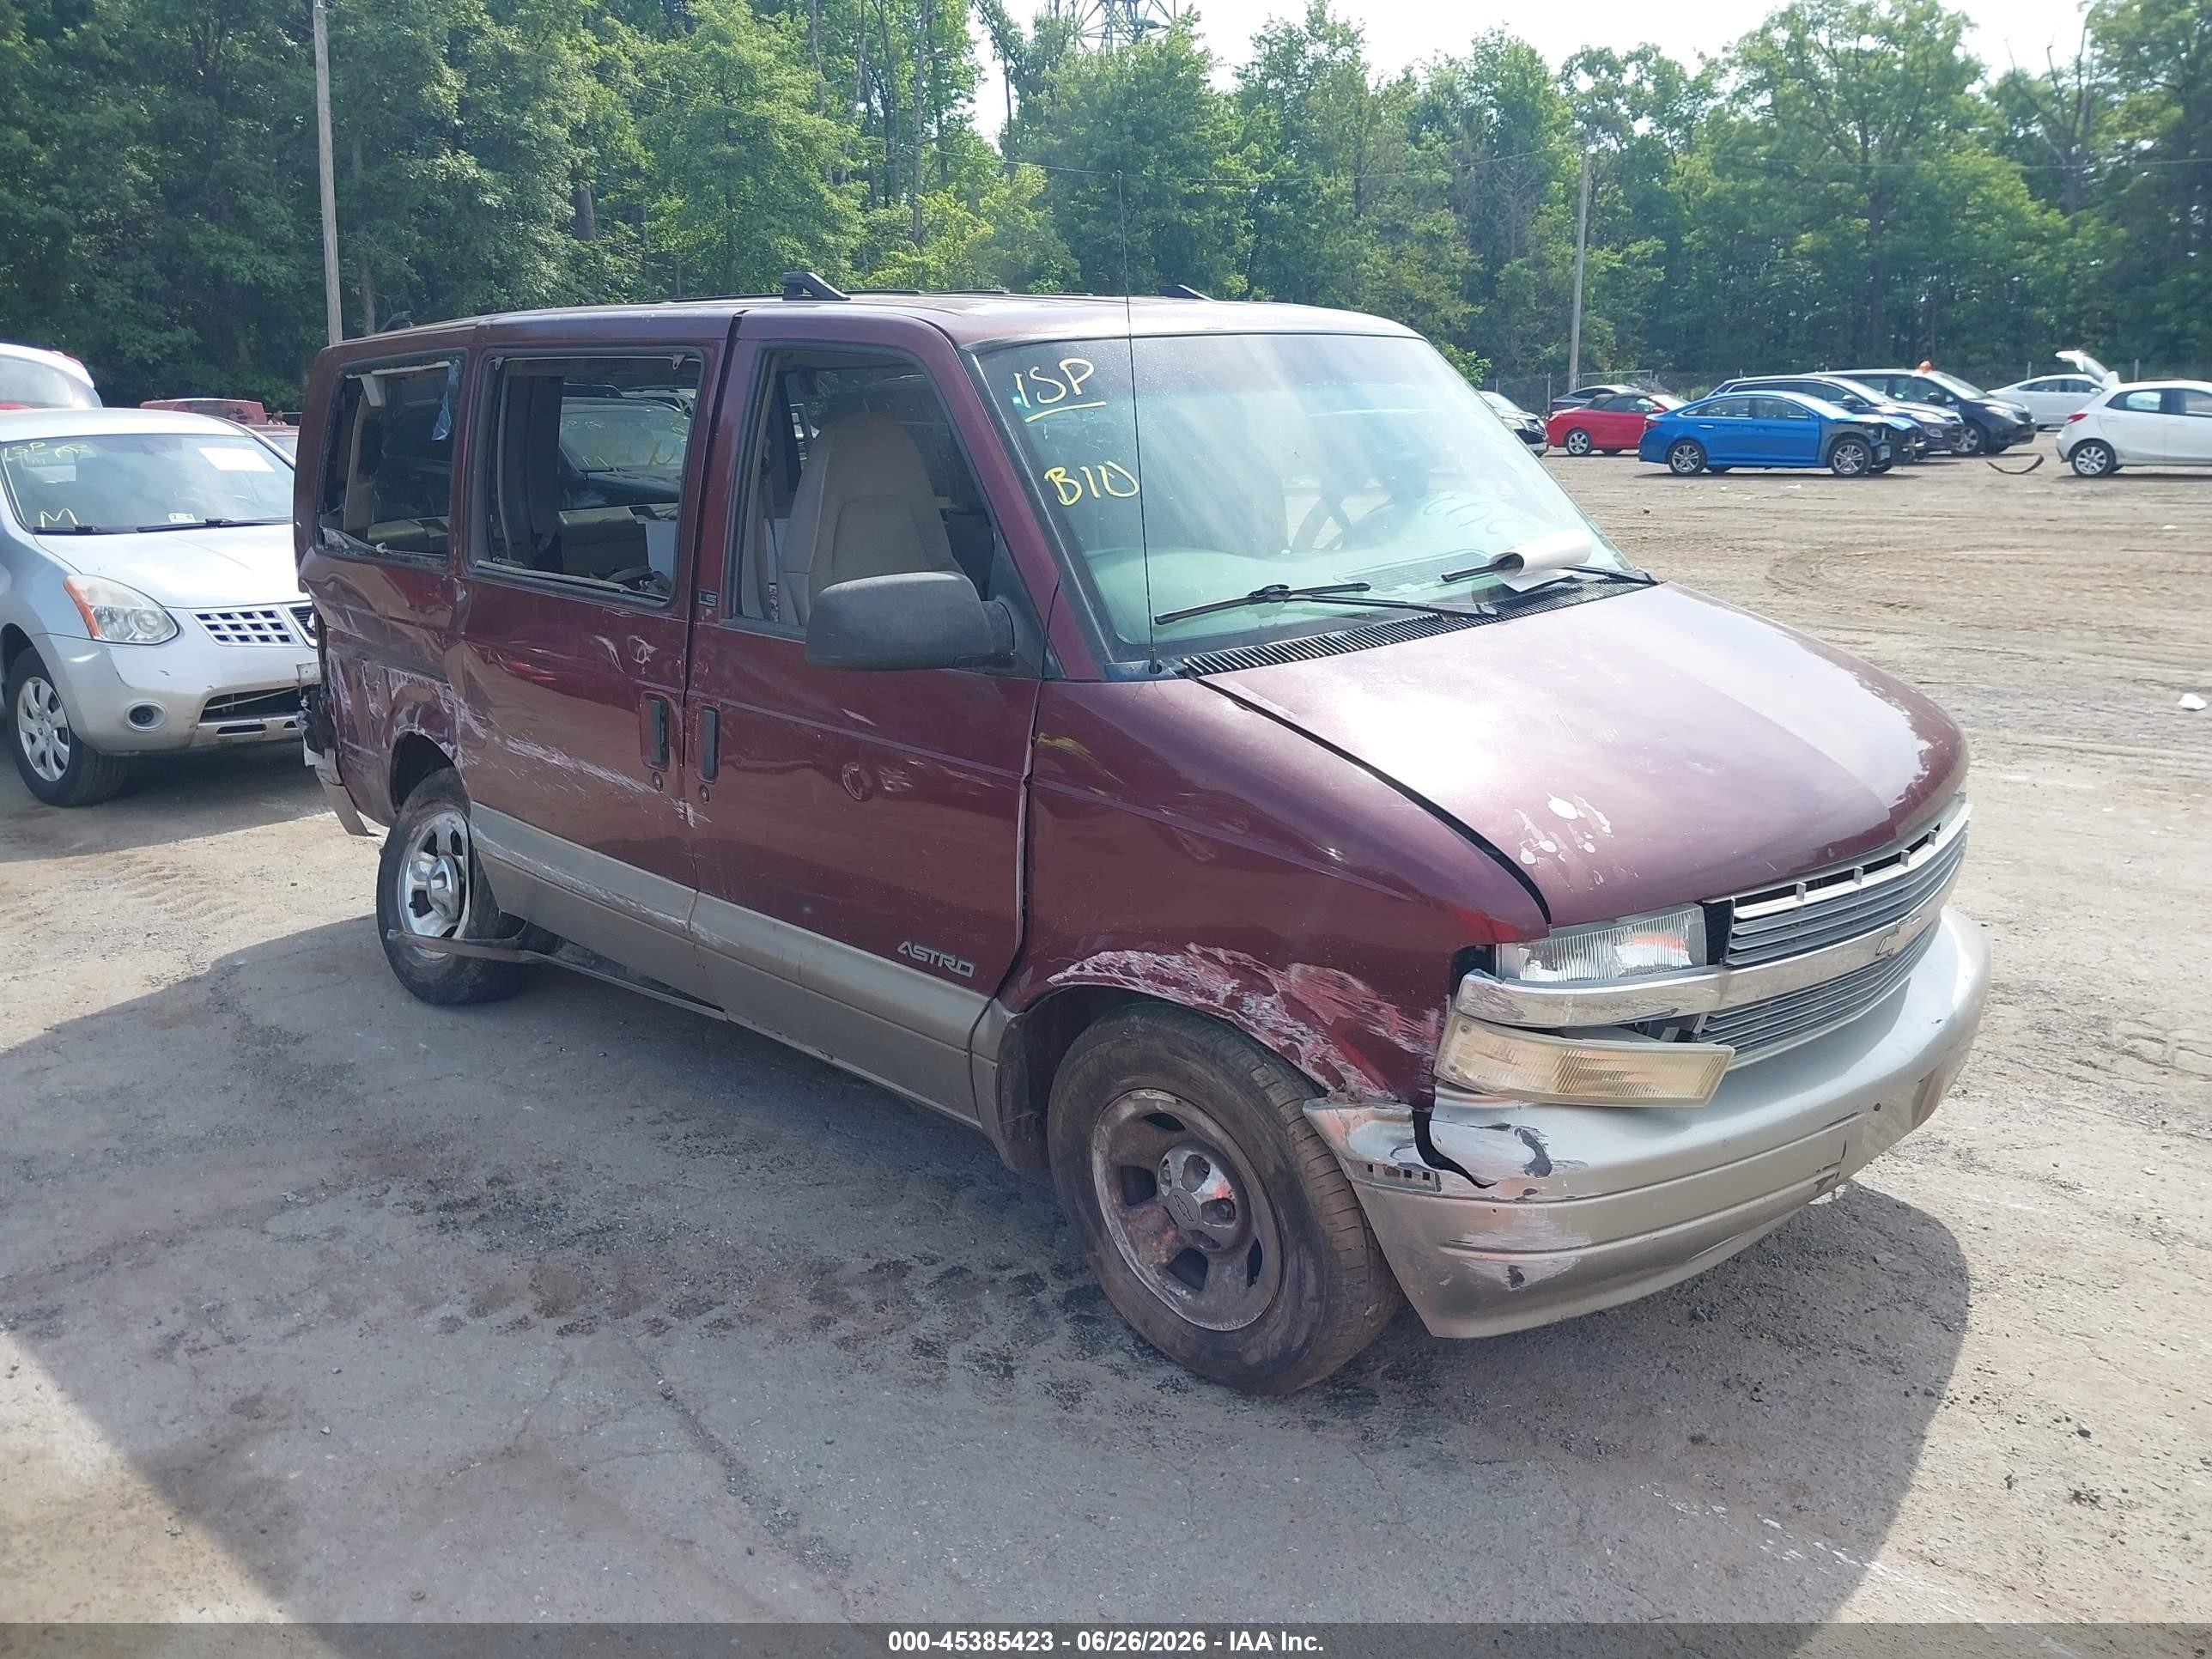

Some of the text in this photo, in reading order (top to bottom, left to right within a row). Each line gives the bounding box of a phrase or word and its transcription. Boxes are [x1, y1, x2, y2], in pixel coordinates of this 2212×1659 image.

[40, 507, 79, 528] M
[698, 591, 718, 607] LS
[896, 940, 975, 978] ASTRO
